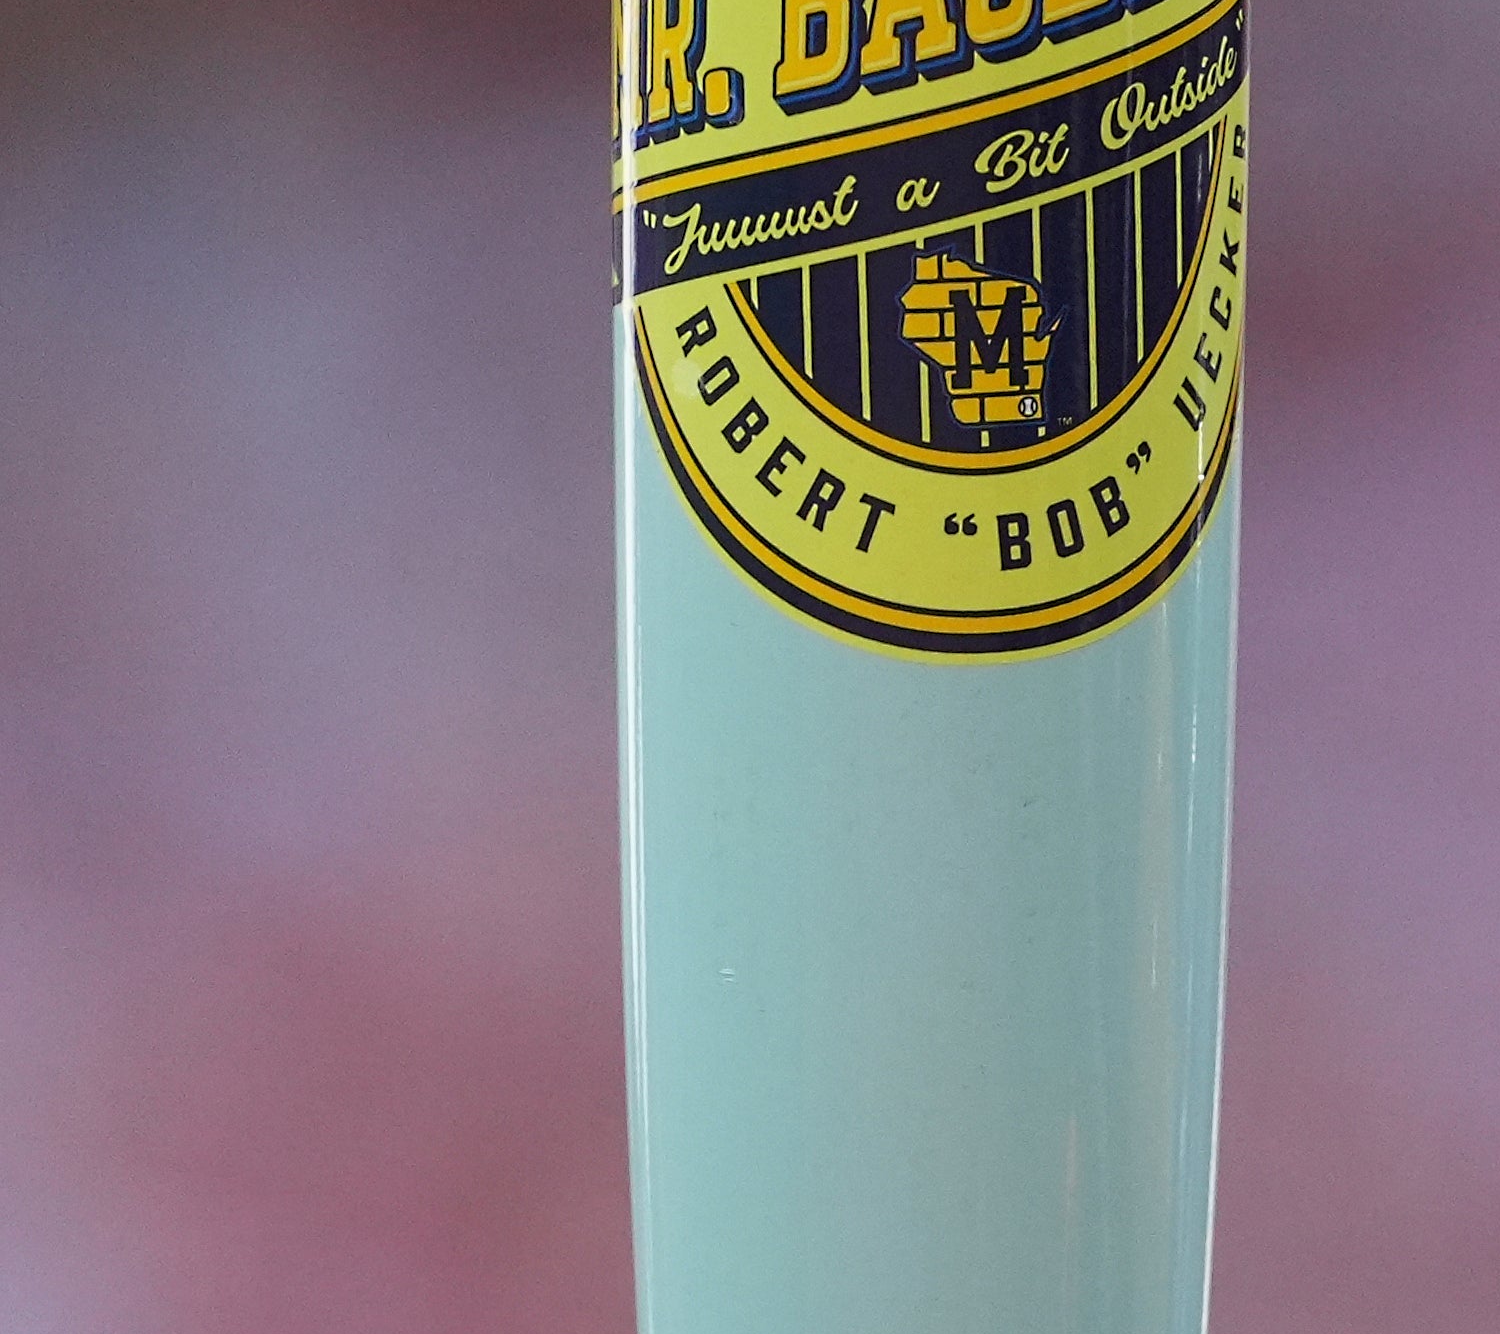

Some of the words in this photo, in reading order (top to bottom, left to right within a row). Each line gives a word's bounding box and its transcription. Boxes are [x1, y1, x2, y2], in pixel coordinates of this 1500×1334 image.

[896, 174, 939, 212] a
[974, 121, 1070, 193] Bit
[673, 303, 896, 554] ROBERT
